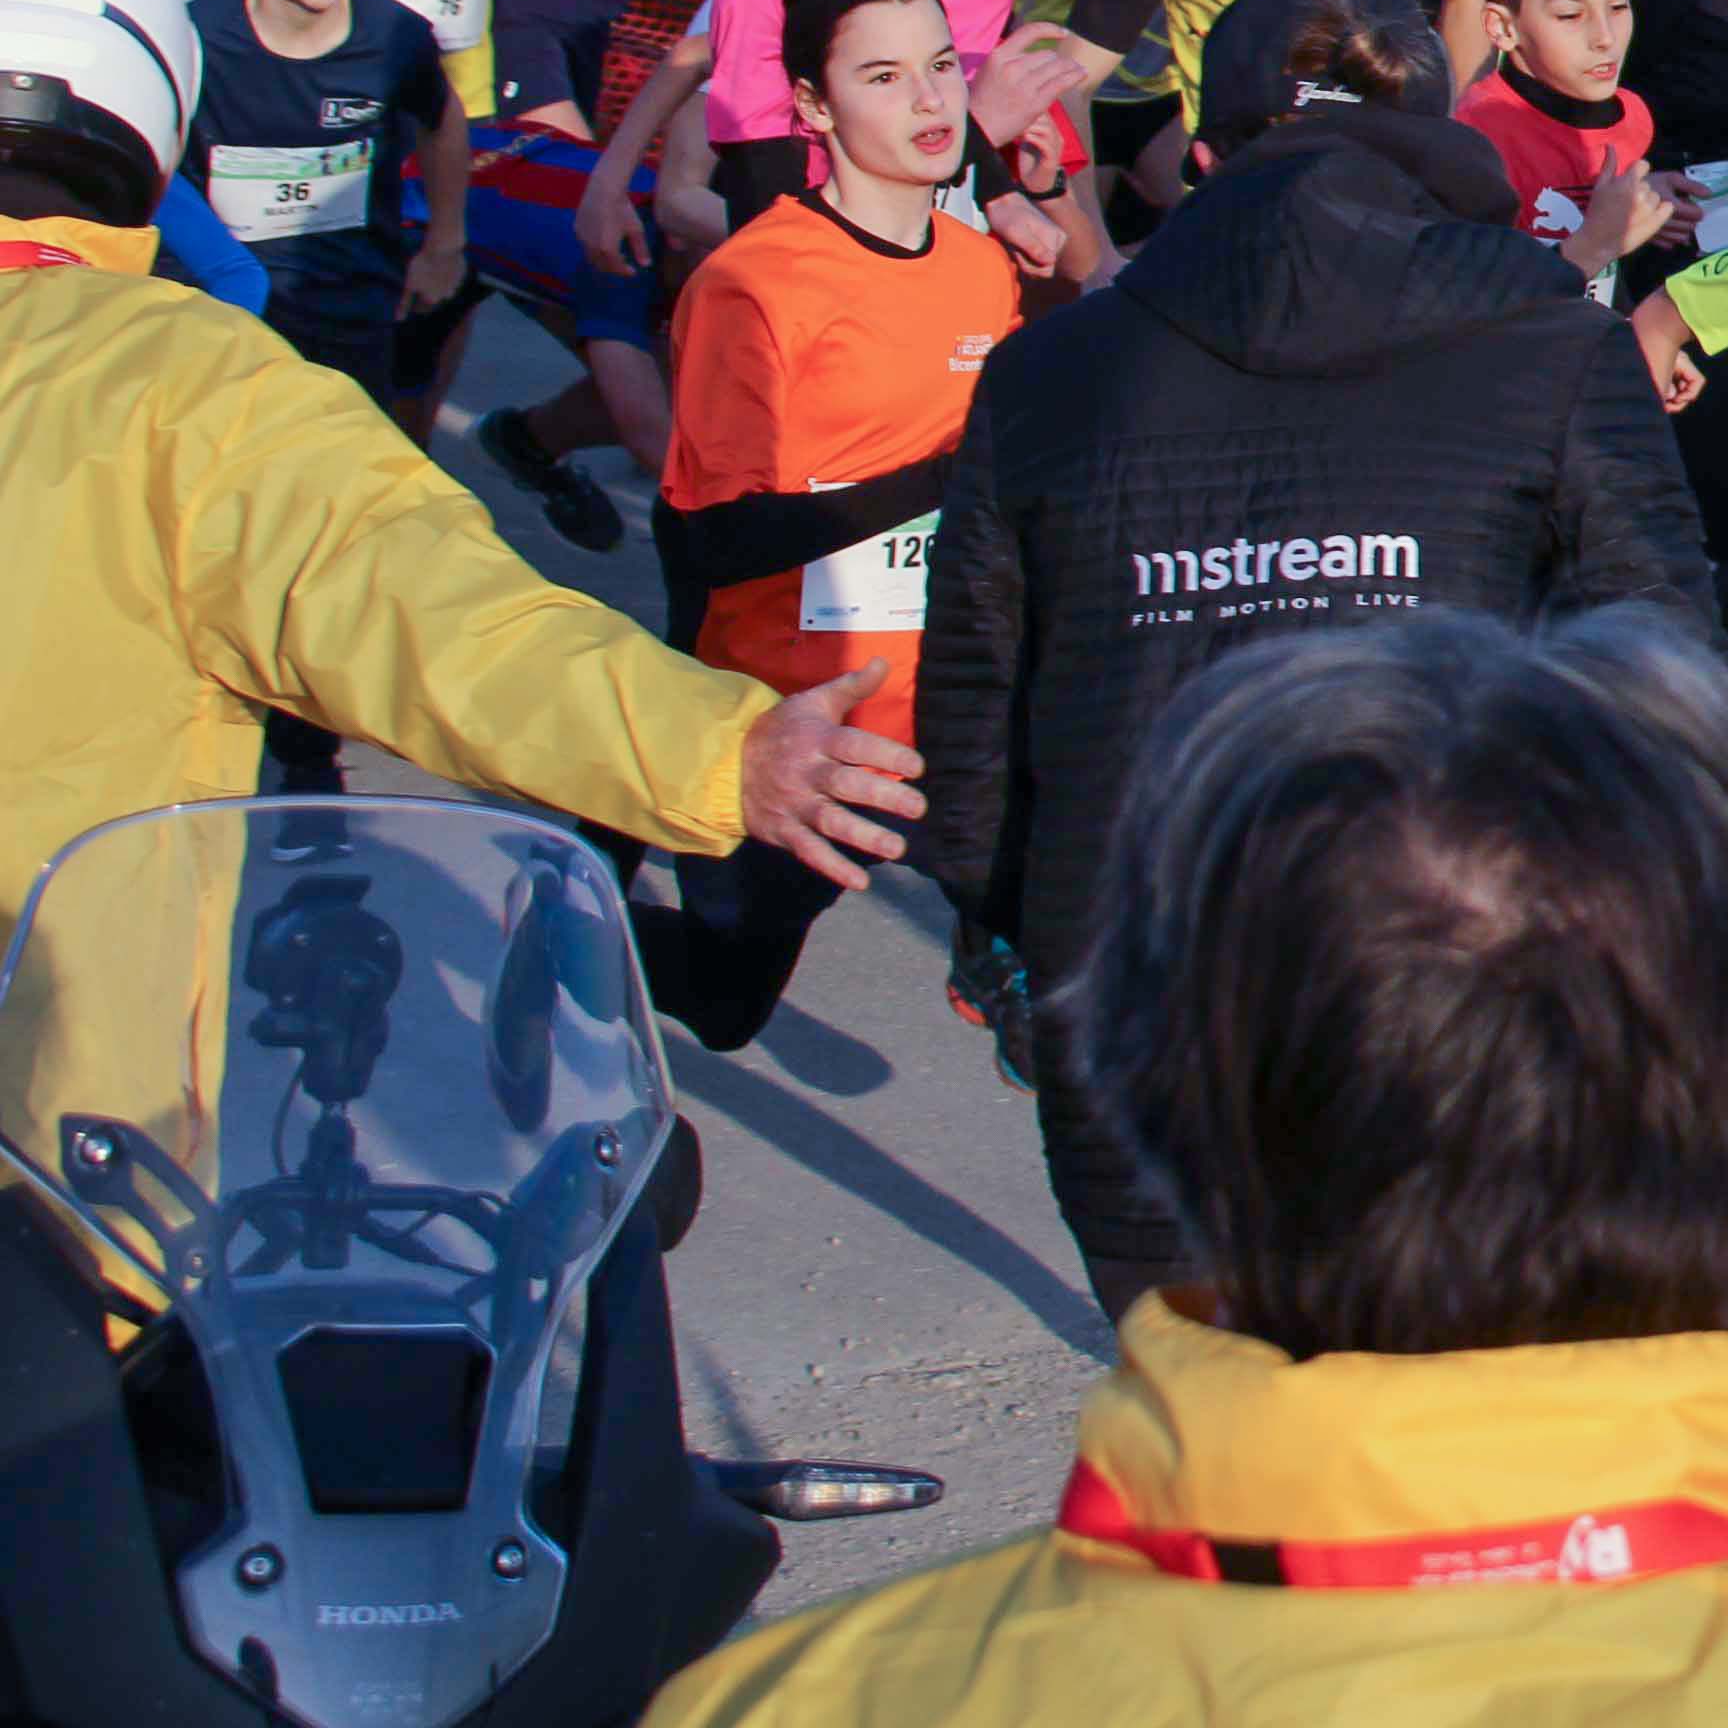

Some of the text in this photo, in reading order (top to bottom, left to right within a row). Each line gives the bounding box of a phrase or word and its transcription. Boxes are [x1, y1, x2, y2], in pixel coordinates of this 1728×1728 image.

[275, 183, 311, 203] 36
[1131, 593, 1421, 627] FILM MOTION LIVE
[316, 1601, 465, 1625] HONDA
